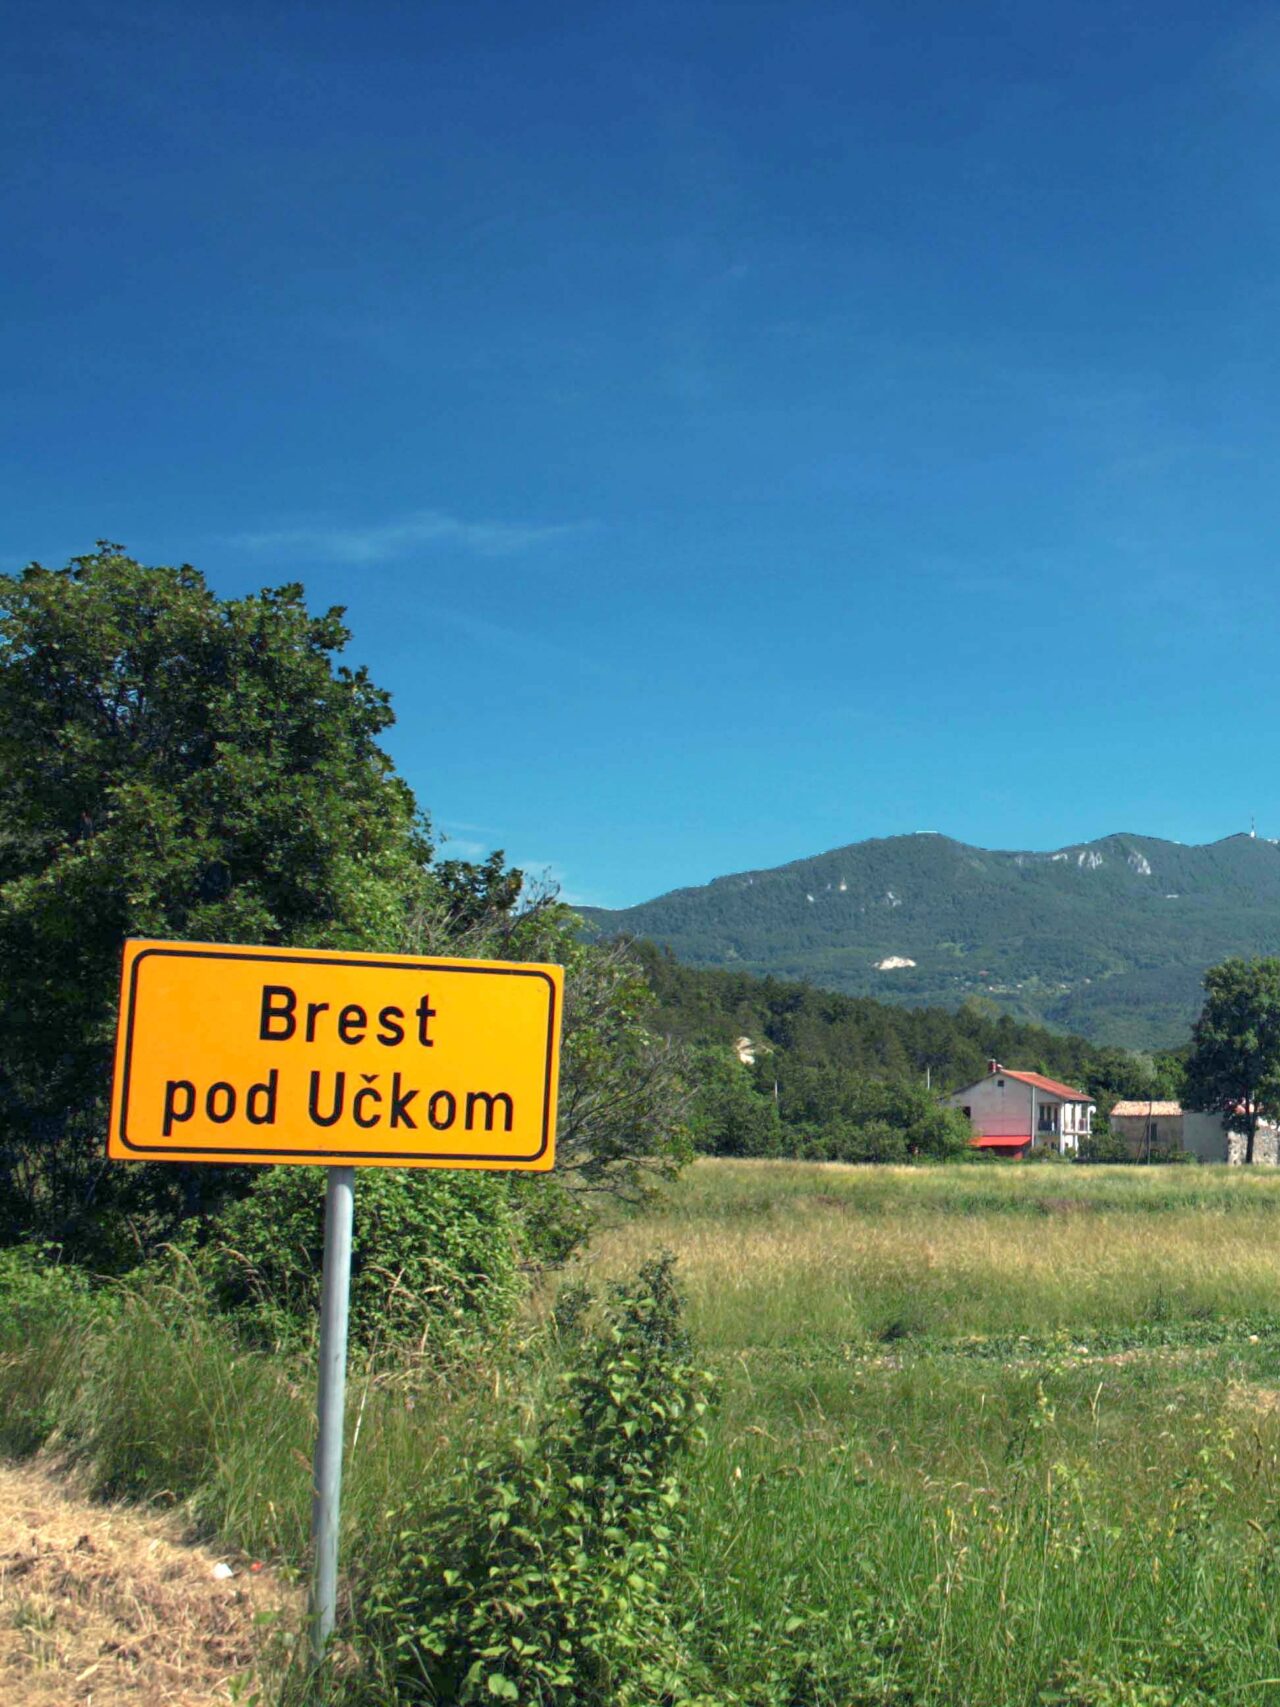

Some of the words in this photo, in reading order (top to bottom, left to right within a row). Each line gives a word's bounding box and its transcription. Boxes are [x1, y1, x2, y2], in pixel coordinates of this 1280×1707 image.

[259, 985, 437, 1047] Brest
[162, 1069, 278, 1137] pod
[308, 1070, 514, 1132] Učkom
